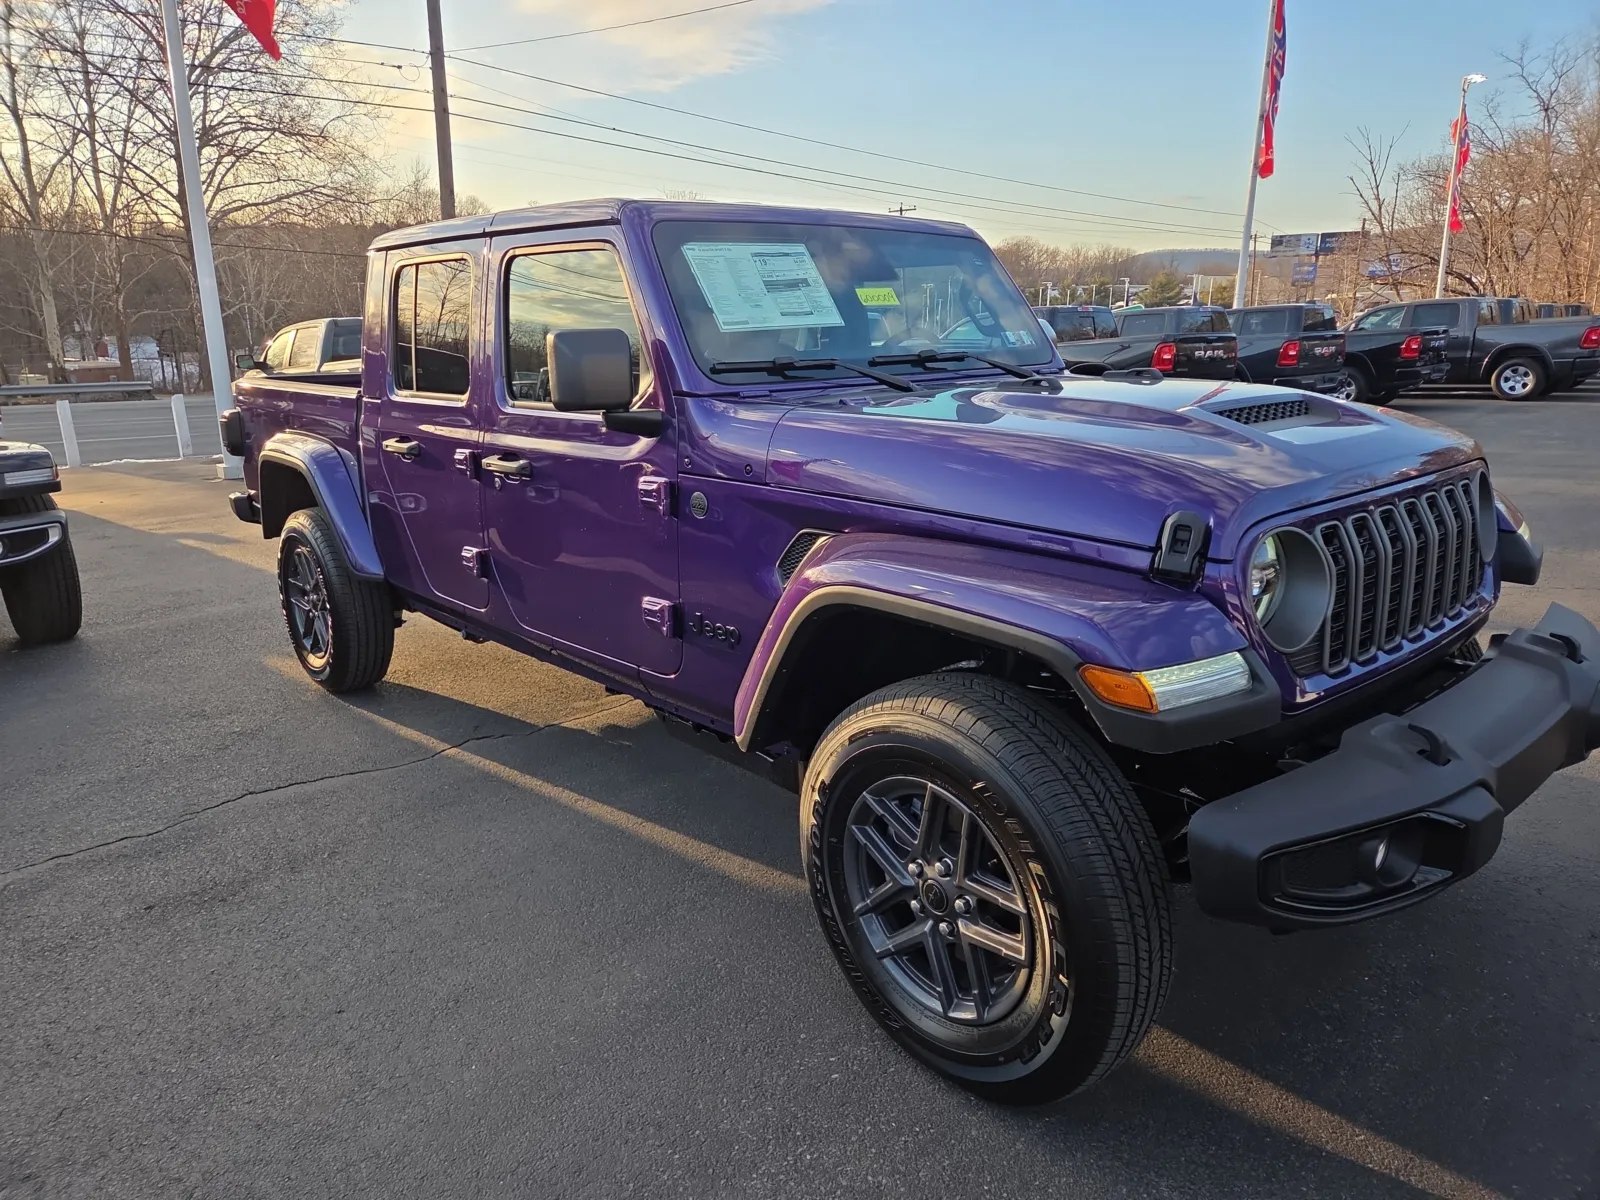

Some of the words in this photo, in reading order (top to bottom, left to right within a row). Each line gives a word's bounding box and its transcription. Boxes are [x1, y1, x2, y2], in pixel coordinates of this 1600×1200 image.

[758, 258, 768, 266] 19
[1194, 349, 1224, 359] RAM
[1313, 346, 1337, 355] RAM
[689, 612, 742, 651] Jeep
